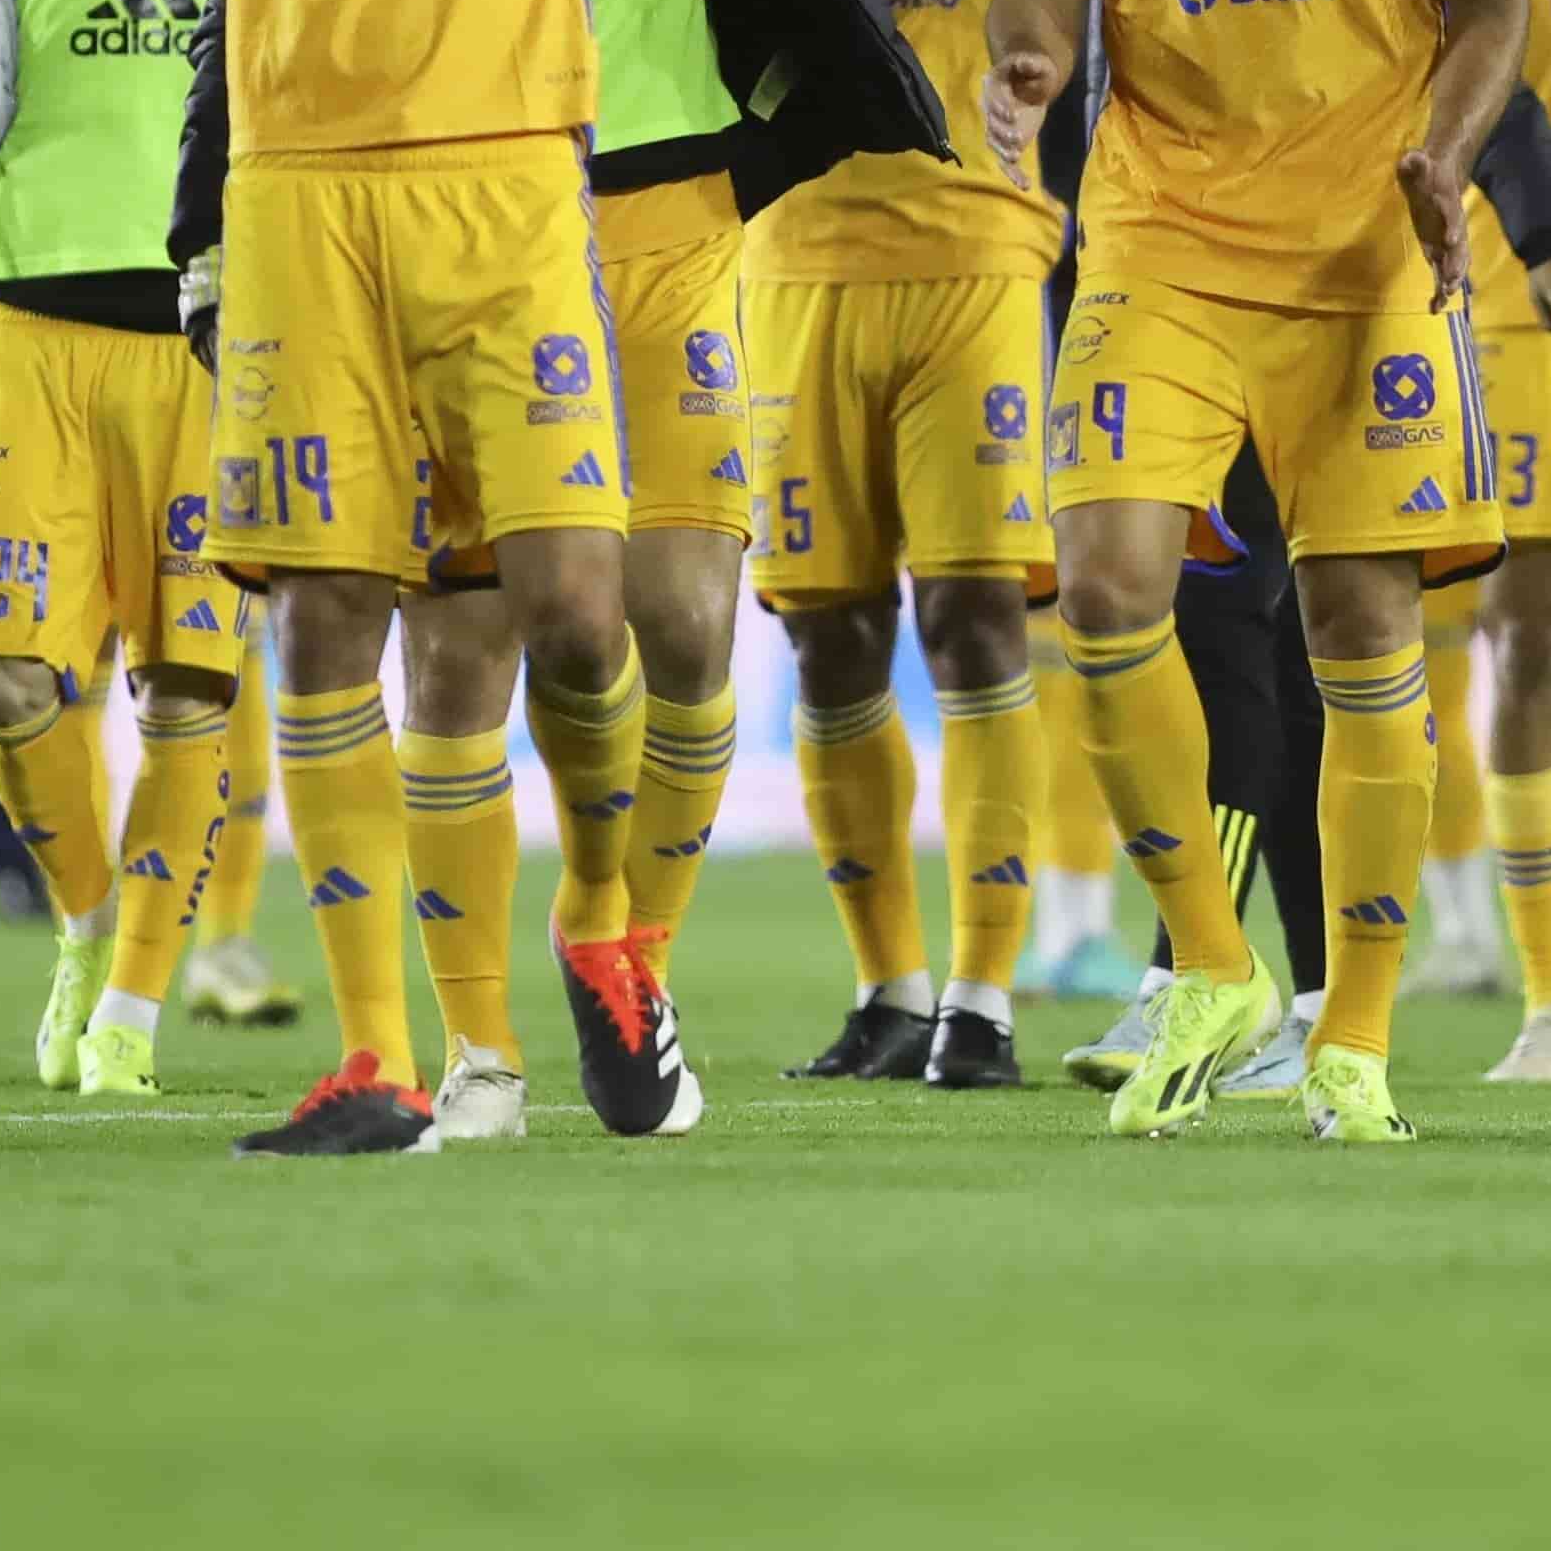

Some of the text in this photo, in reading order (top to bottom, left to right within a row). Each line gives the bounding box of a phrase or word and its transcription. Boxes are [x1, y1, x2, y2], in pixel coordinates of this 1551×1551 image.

[1092, 381, 1127, 461] 9
[1403, 426, 1444, 444] GAS
[265, 434, 333, 526] 19
[780, 476, 813, 554] 5
